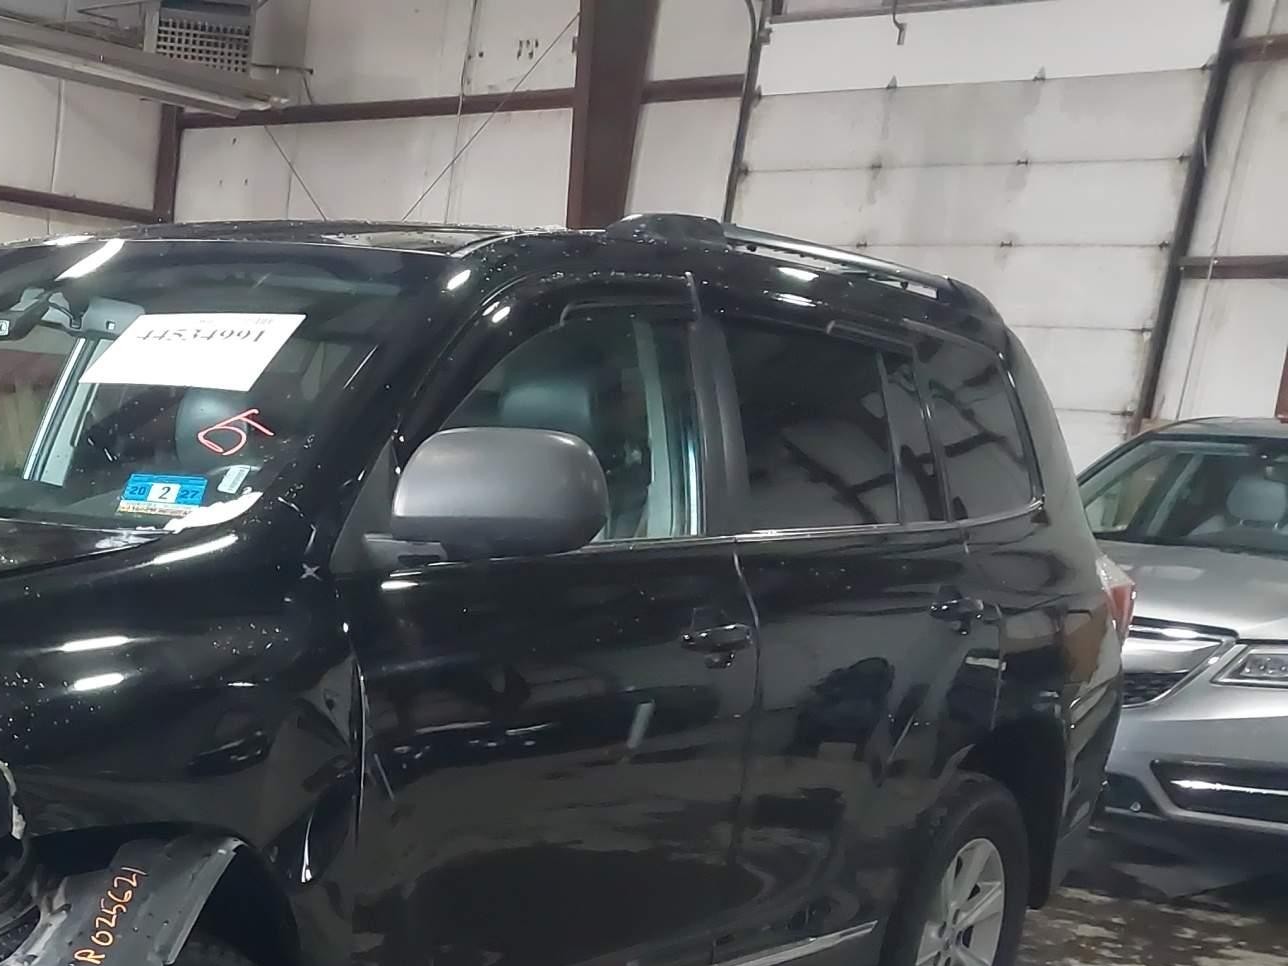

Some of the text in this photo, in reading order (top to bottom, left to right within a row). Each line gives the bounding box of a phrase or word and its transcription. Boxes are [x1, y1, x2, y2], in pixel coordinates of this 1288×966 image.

[128, 486, 200, 500] 20 2 27
